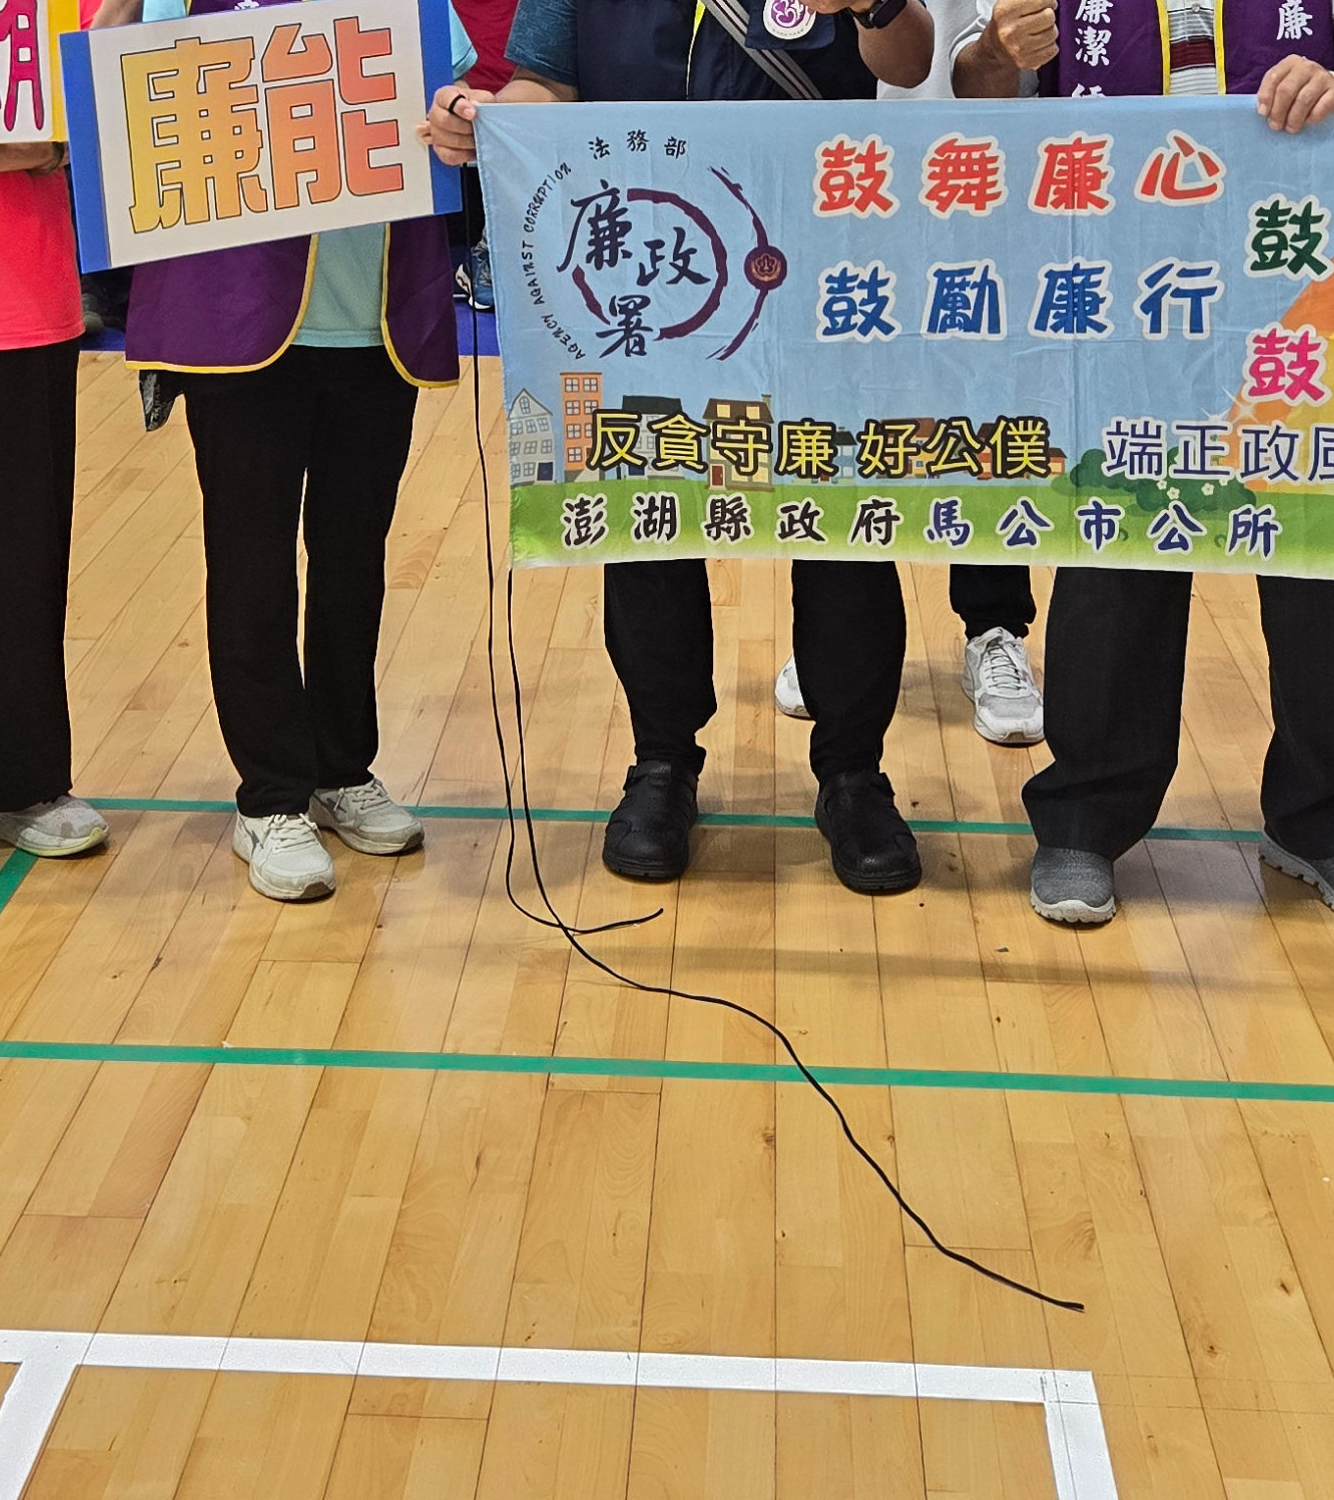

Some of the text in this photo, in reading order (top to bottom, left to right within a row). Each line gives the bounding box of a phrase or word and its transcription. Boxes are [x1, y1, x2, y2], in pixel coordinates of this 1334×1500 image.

[120, 15, 405, 234] 廉能
[588, 129, 687, 160] 法務部
[816, 135, 1222, 215] 鼓舞廉心
[521, 161, 586, 360] AGENCY AGAINST CORRUPTION
[556, 178, 711, 360] 廉政署
[818, 261, 1221, 339] 鼓勵廉行
[590, 411, 1051, 479] 反貪守廉 好公僕
[562, 495, 1279, 559] 澎湖縣政府馬公市公所
